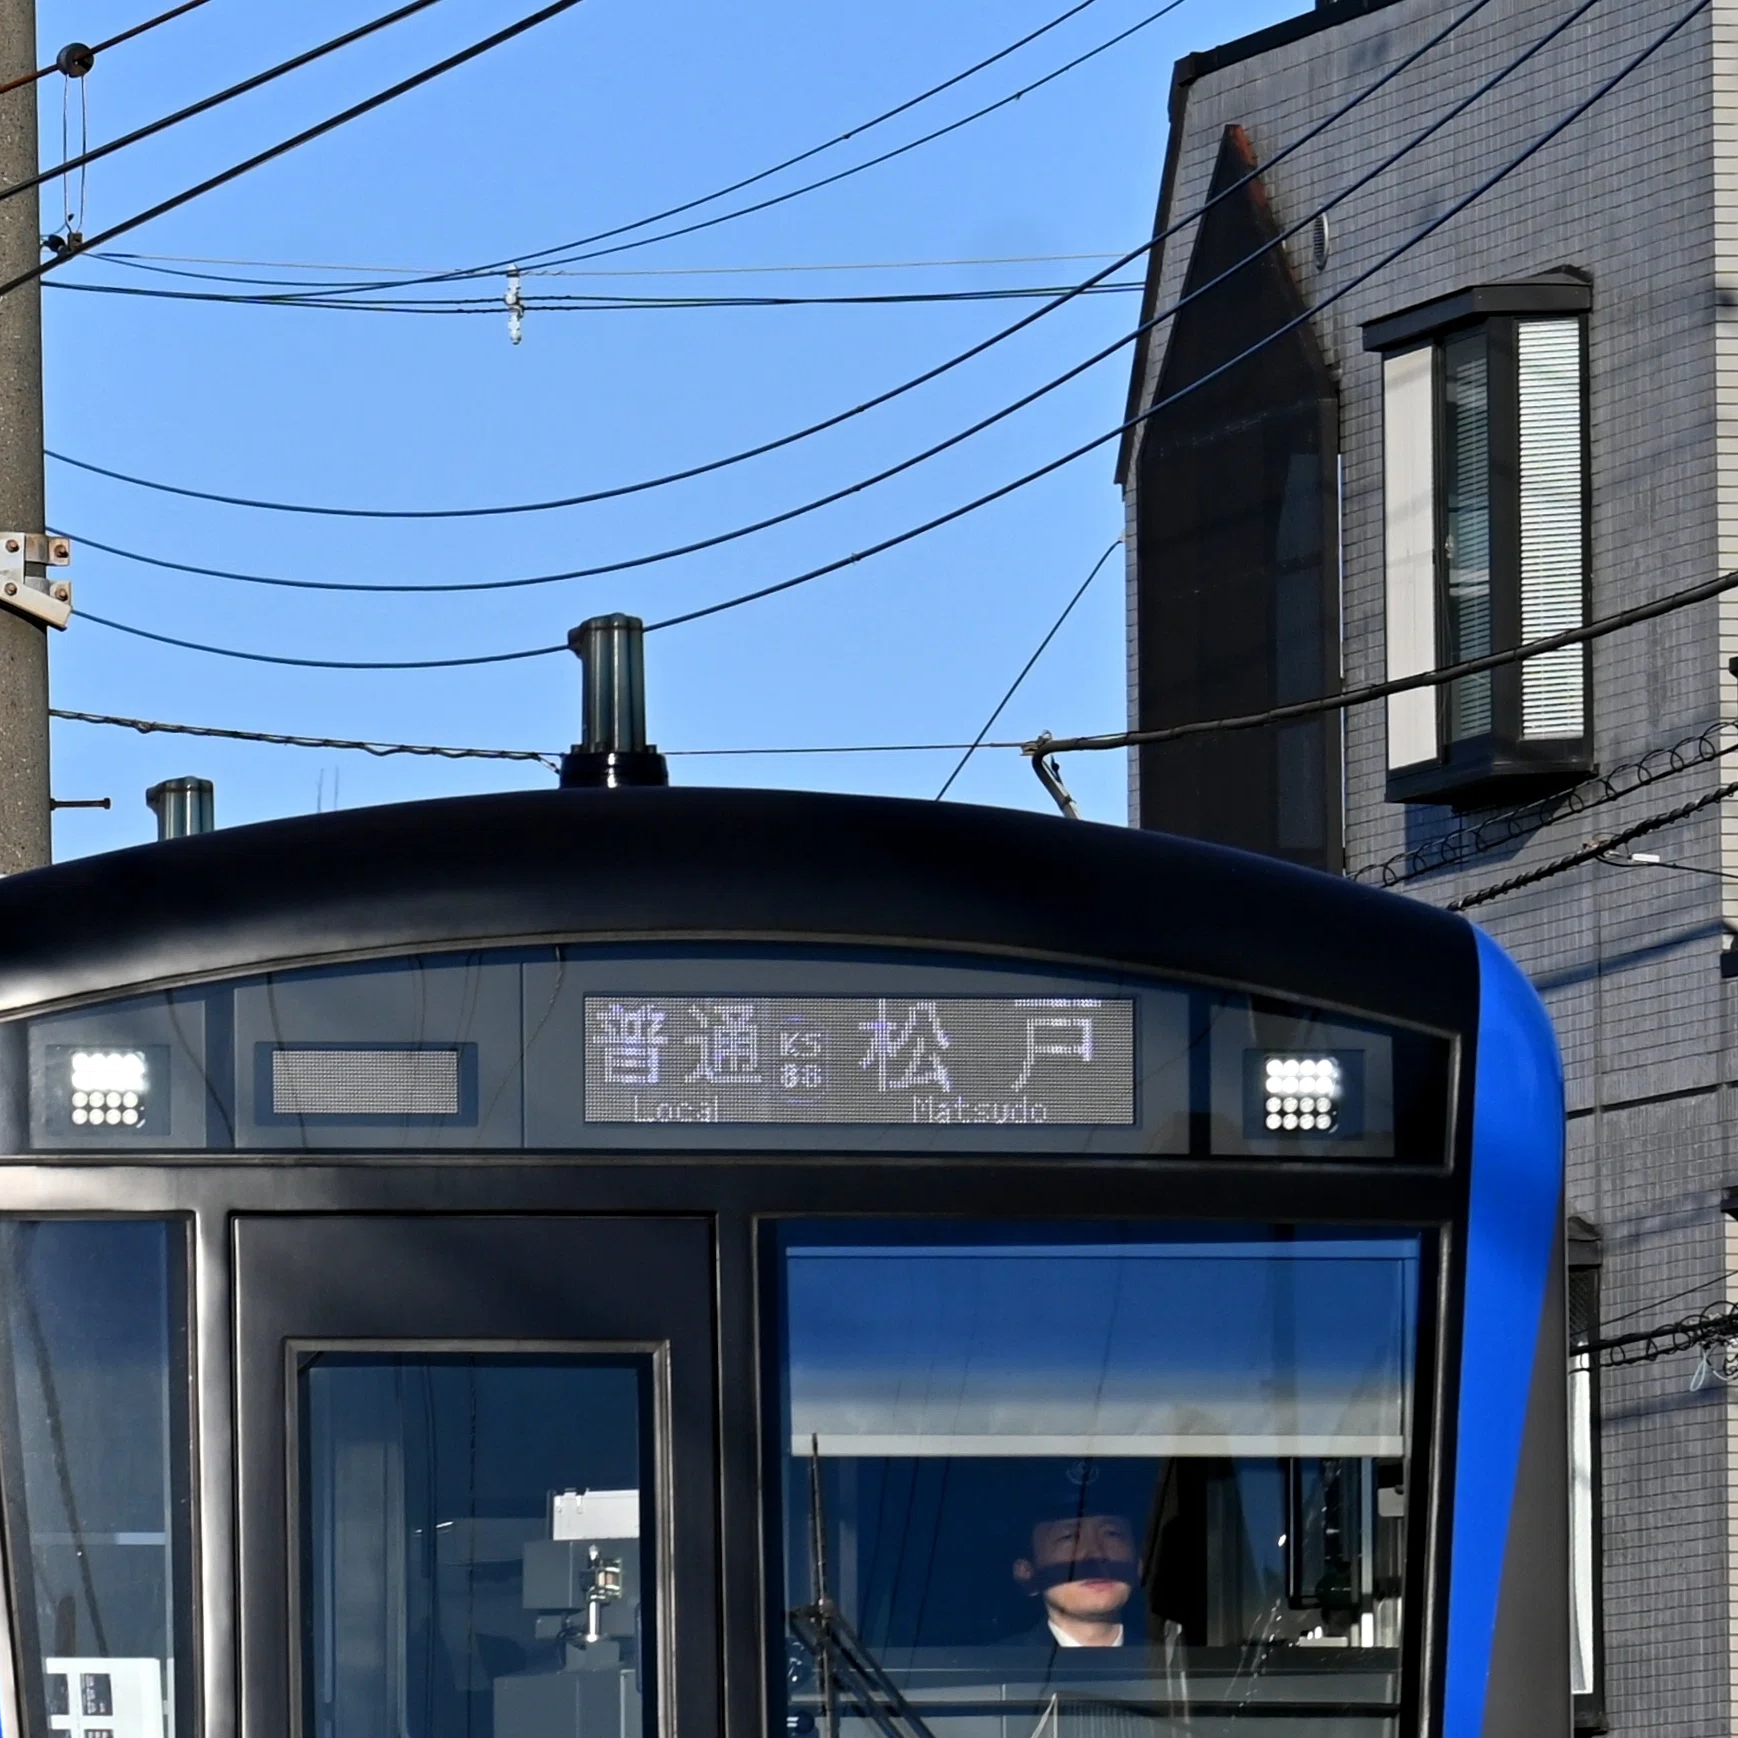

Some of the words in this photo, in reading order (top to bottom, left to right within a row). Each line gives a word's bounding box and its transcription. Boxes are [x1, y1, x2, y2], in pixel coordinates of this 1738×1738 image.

[592, 1003, 763, 1084] 普通
[780, 1032, 822, 1057] KS
[858, 998, 1103, 1093] 松戸
[633, 1094, 719, 1123] Local
[912, 1095, 1047, 1125] Matsudo
